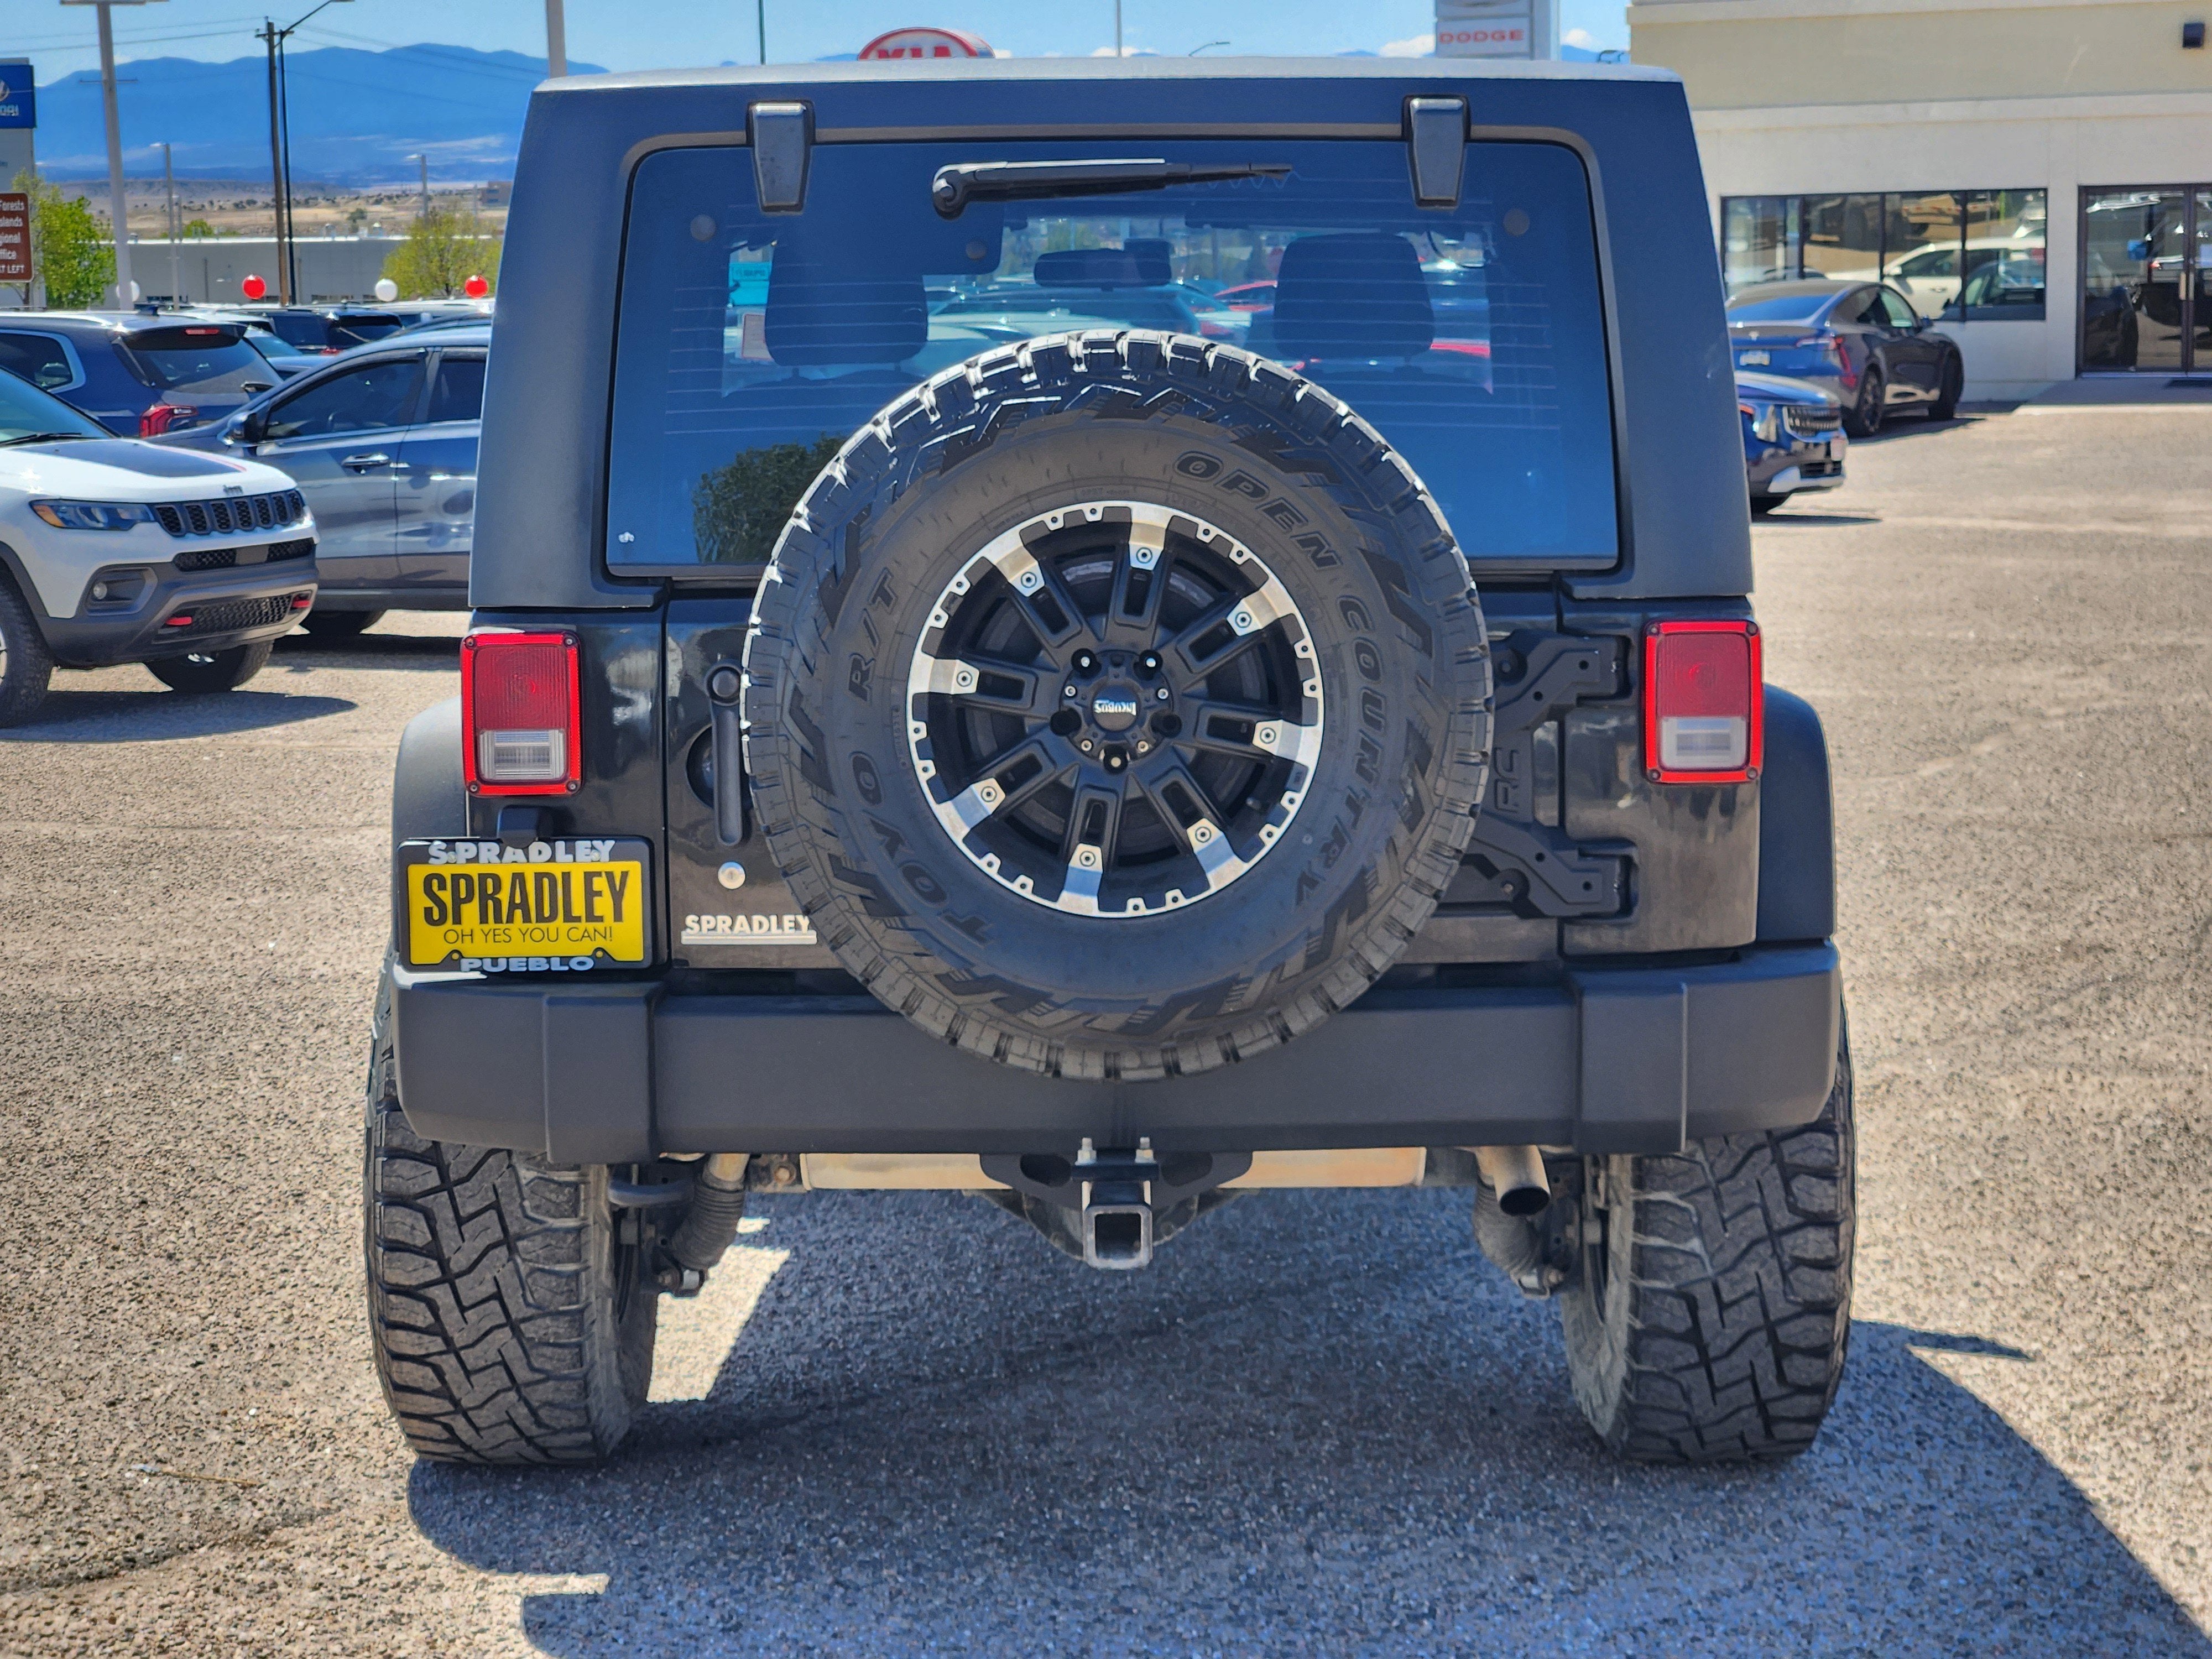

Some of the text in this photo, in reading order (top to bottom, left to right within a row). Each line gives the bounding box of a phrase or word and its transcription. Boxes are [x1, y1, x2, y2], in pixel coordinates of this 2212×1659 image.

[1439, 29, 1524, 44] DODGE
[1173, 450, 1385, 906] OPEN COUNTRY
[847, 566, 993, 944] TOYO R/T
[427, 839, 615, 865] SPRADLEY
[422, 870, 630, 926] SPRADLEY
[444, 926, 613, 944] OH YES YOU CAN!
[685, 914, 810, 935] SPRADLEY
[460, 956, 594, 973] PUEBLO
